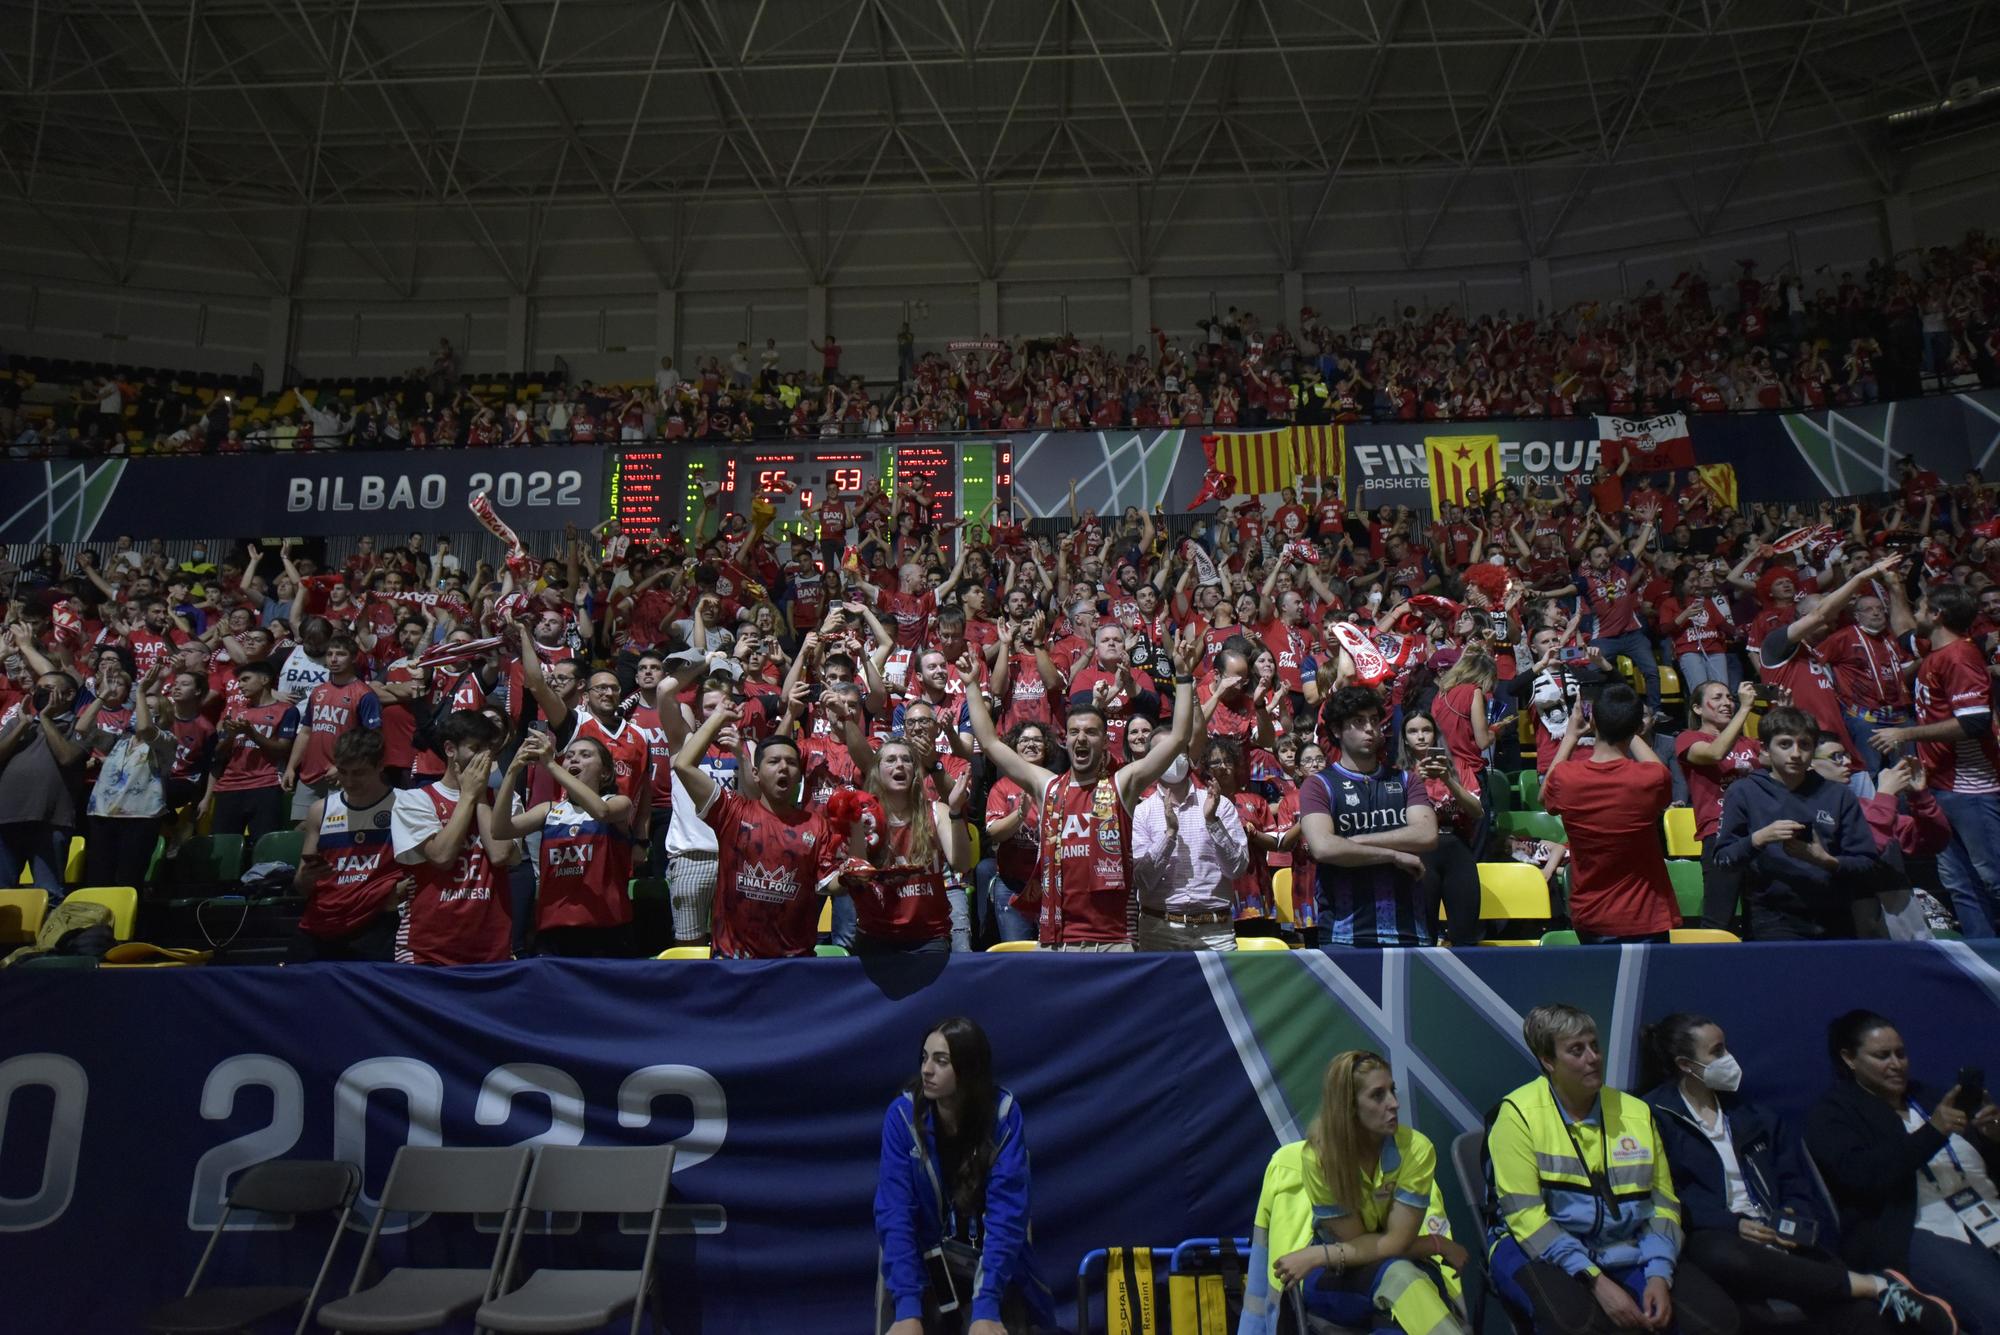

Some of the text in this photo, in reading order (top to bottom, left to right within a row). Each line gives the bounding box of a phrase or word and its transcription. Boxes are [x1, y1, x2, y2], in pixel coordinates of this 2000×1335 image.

[728, 460, 735, 470] 4
[1354, 444, 1428, 476] FIN
[612, 473, 619, 483] 2
[728, 471, 735, 480] 4
[887, 466, 894, 477] 3
[721, 481, 734, 491] 18
[835, 469, 861, 490] 53
[997, 474, 1010, 485] 13
[1364, 478, 1430, 490] BASKETB
[287, 470, 582, 512] BILBAO 2022
[612, 484, 618, 494] 5
[611, 495, 617, 505] 6
[801, 491, 812, 507] 4
[287, 669, 327, 683] BAX
[432, 689, 475, 704] BXI
[650, 747, 670, 757] RESA
[1100, 828, 1121, 841] BAX
[549, 843, 593, 866] BAXI
[738, 875, 797, 895] FINAL FOUR
[897, 882, 934, 898] ANRESA
[188, 1055, 728, 1235] 2022
[1142, 1281, 1151, 1330] Restraint
